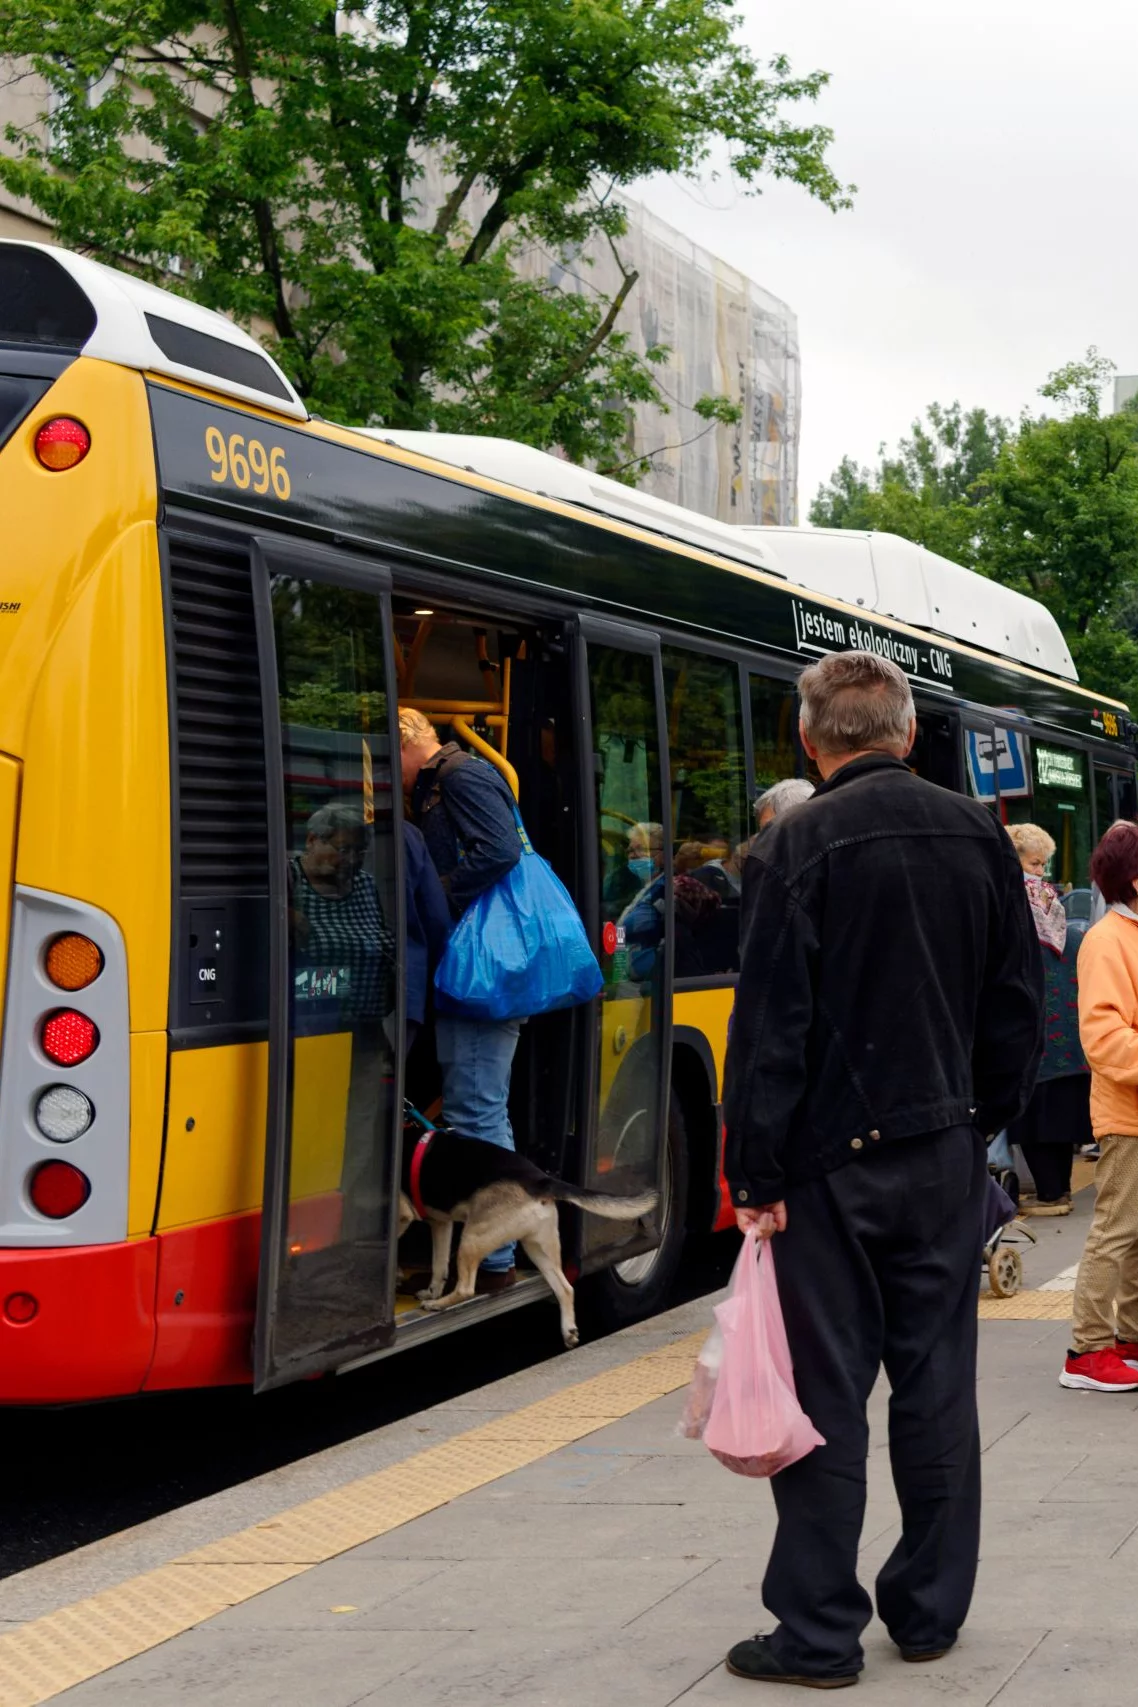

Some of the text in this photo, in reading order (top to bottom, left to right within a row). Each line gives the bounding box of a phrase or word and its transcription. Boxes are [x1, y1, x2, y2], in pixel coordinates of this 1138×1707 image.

[205, 426, 291, 501] 9696
[799, 602, 846, 645] jestem
[849, 621, 918, 674] ekologiczny
[930, 648, 953, 678] CNG
[199, 968, 216, 981] CNG
